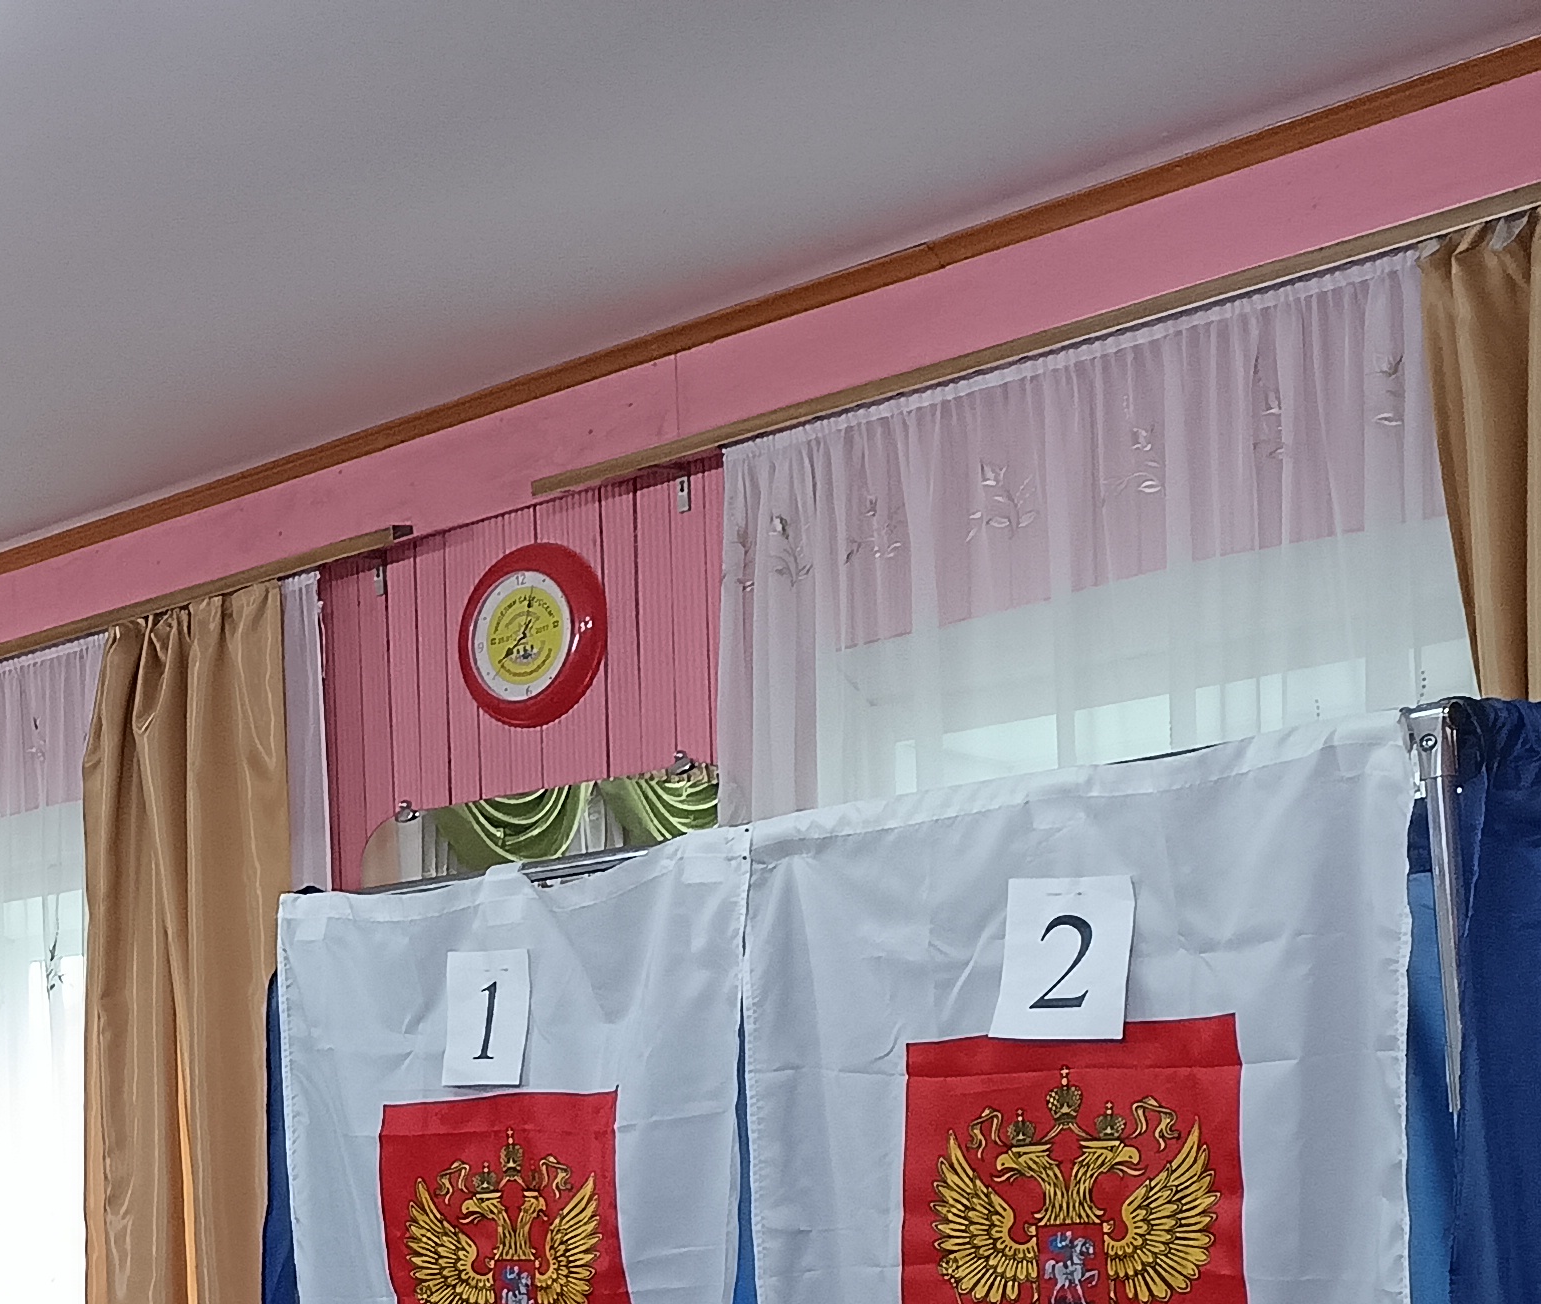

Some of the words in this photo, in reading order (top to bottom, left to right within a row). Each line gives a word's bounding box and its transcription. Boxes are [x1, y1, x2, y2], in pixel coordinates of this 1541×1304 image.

[516, 572, 527, 586] 12
[1027, 914, 1094, 1010] 2
[473, 980, 498, 1061] 1
